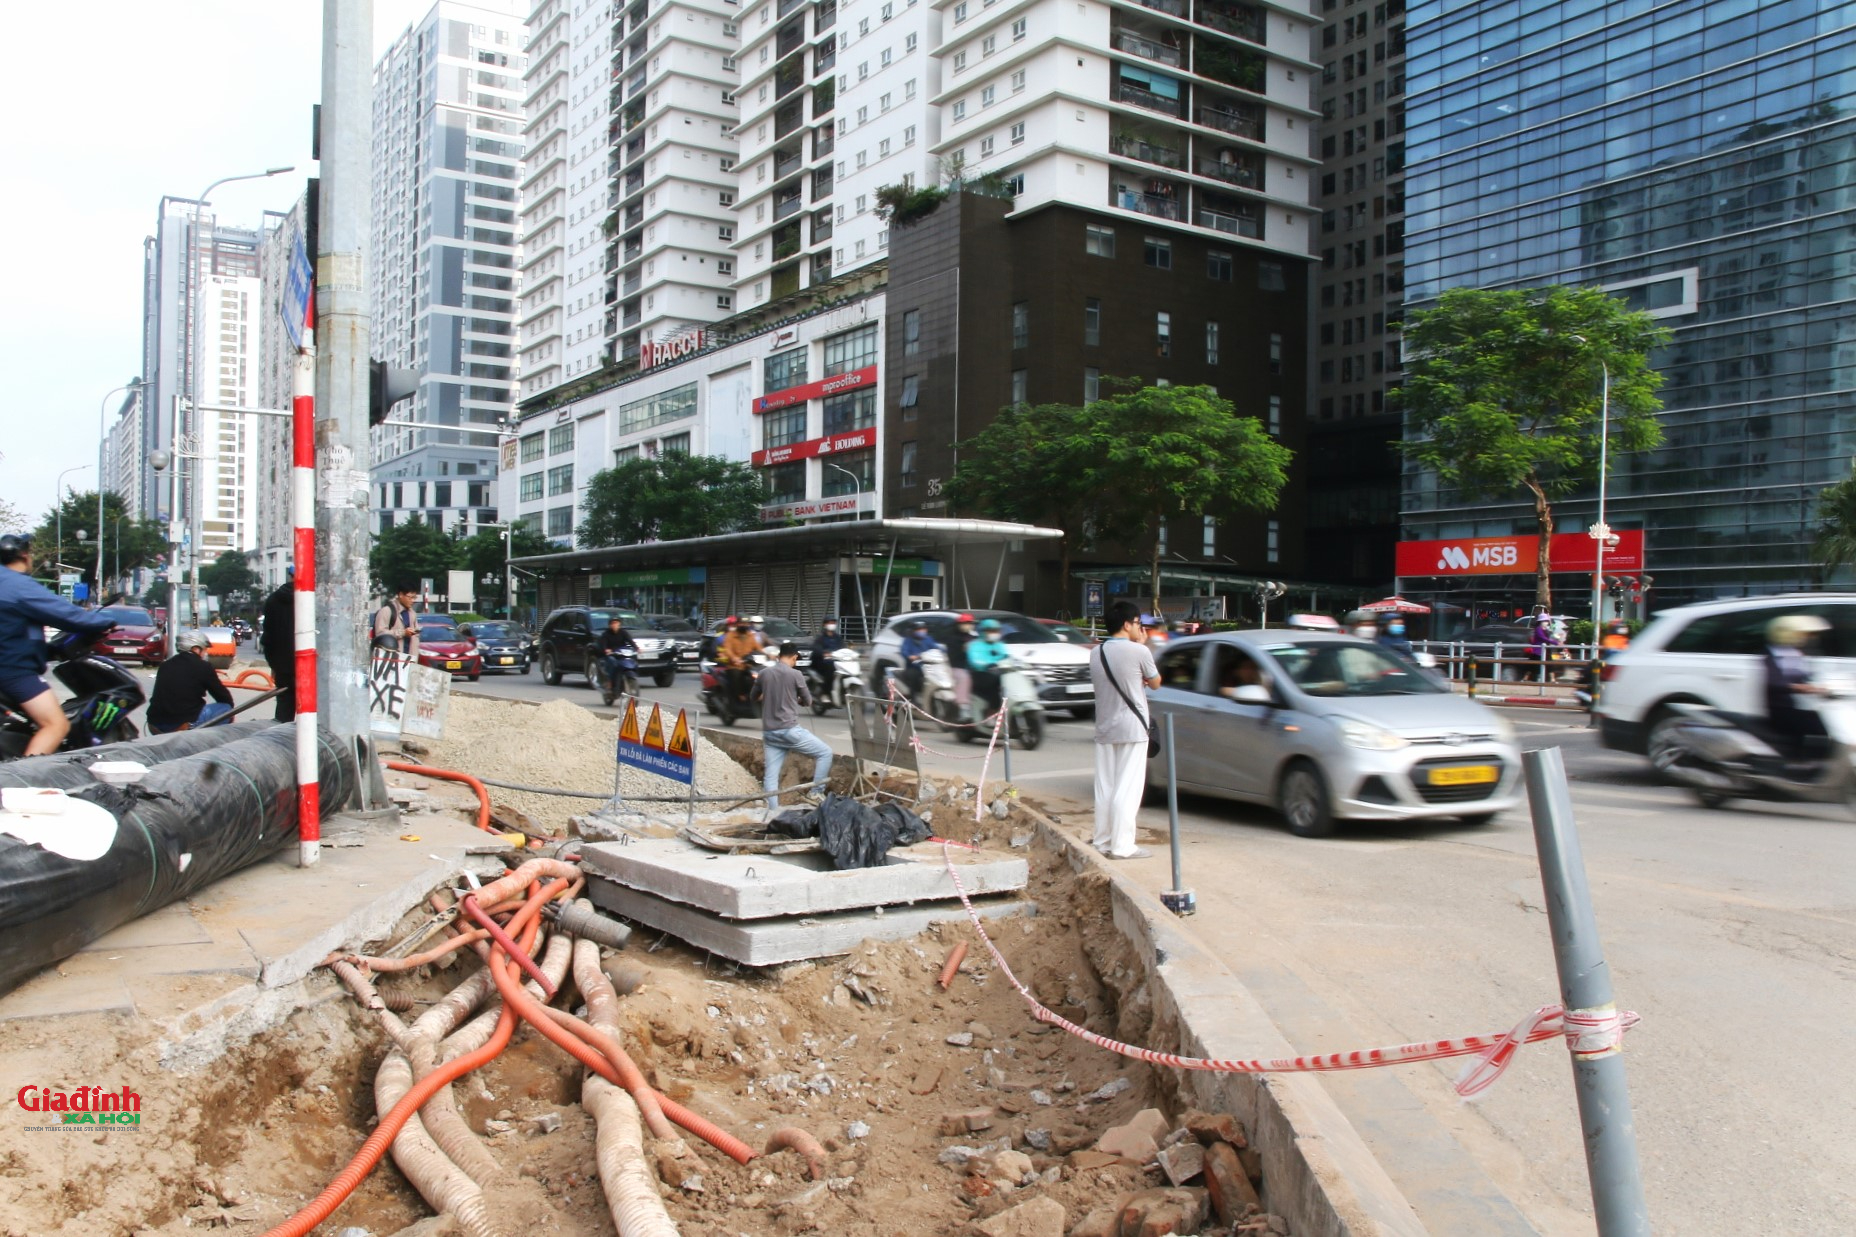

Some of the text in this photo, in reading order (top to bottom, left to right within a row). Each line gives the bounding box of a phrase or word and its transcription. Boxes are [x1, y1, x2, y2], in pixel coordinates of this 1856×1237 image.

[927, 478, 943, 497] 35
[768, 499, 856, 520] PUBL BANK VIETNAM
[1473, 546, 1518, 567] MSB
[370, 680, 406, 720] XE
[668, 761, 678, 772] CÁC
